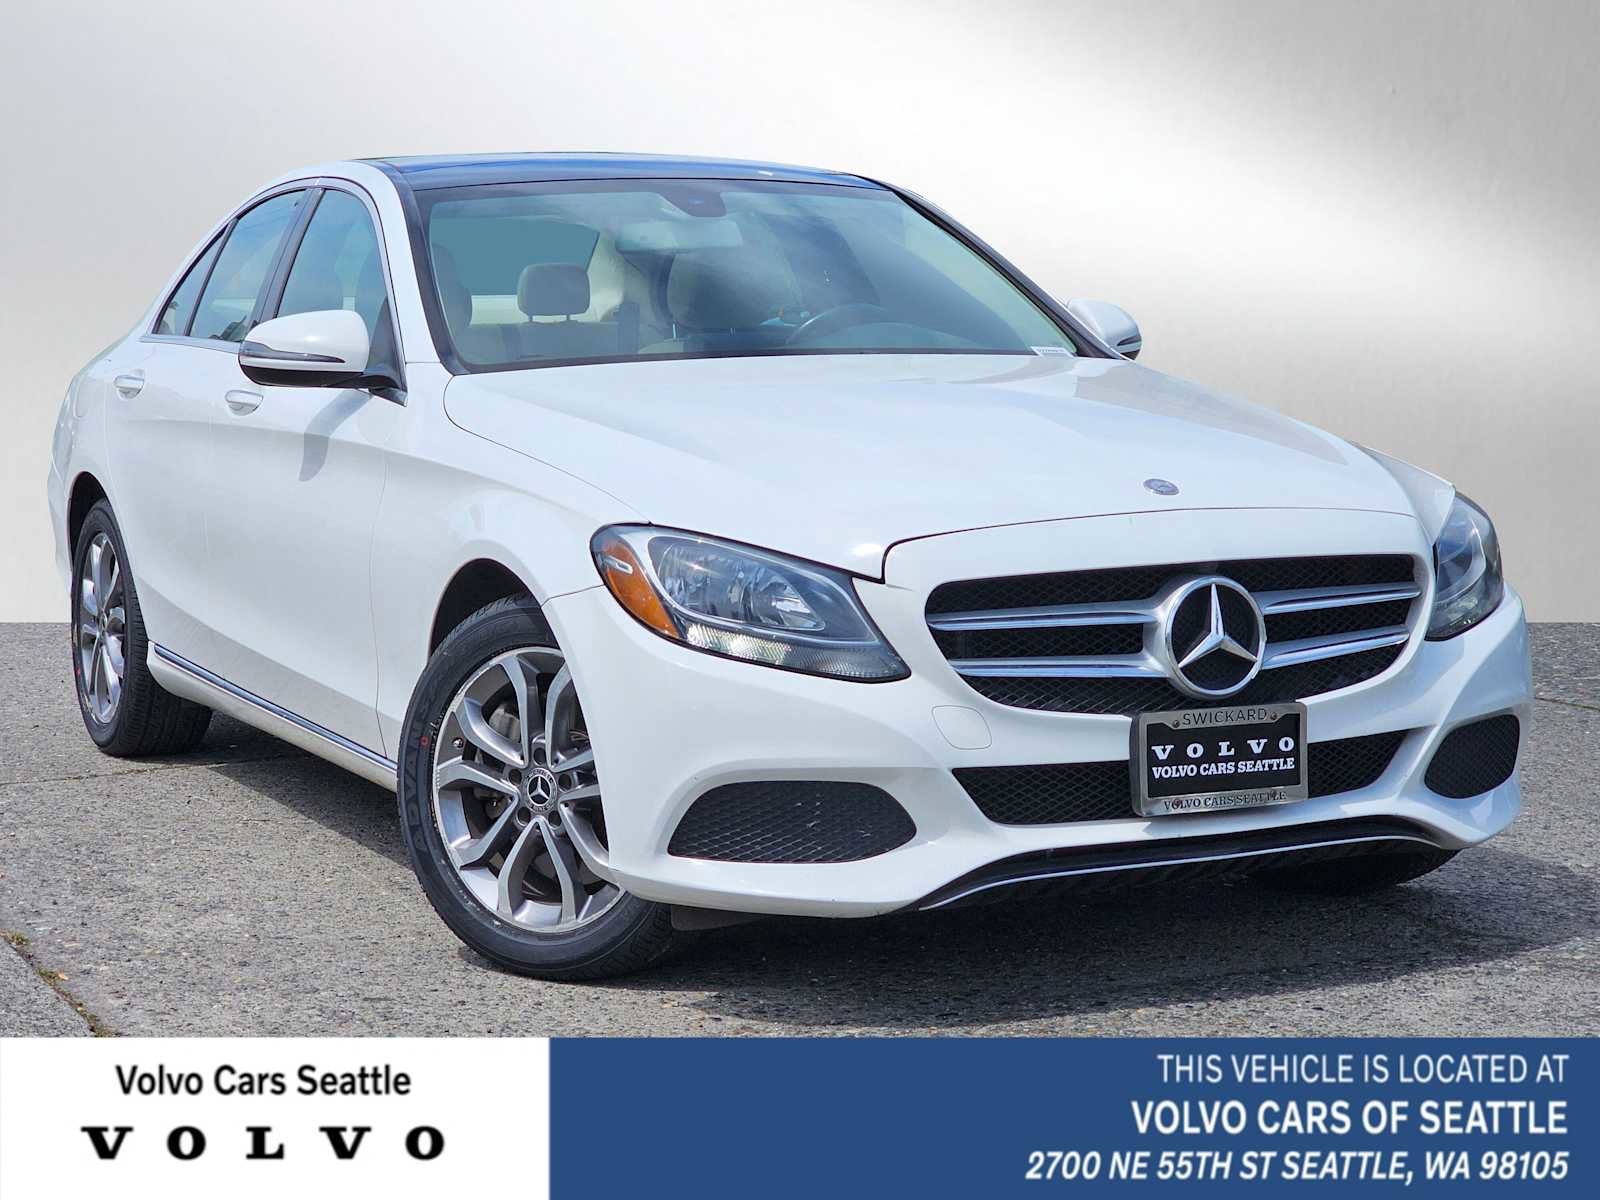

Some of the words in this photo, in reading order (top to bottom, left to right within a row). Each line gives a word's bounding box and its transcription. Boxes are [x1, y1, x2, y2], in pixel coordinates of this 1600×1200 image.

[1182, 708, 1267, 726] SWICKARD
[1151, 736, 1294, 760] VOLVO
[1152, 764, 1197, 779] VOLVO
[1199, 761, 1235, 776] CARS
[1237, 757, 1295, 773] SEATTLE
[1164, 798, 1201, 811] VOLVO
[1204, 795, 1234, 809] CARS
